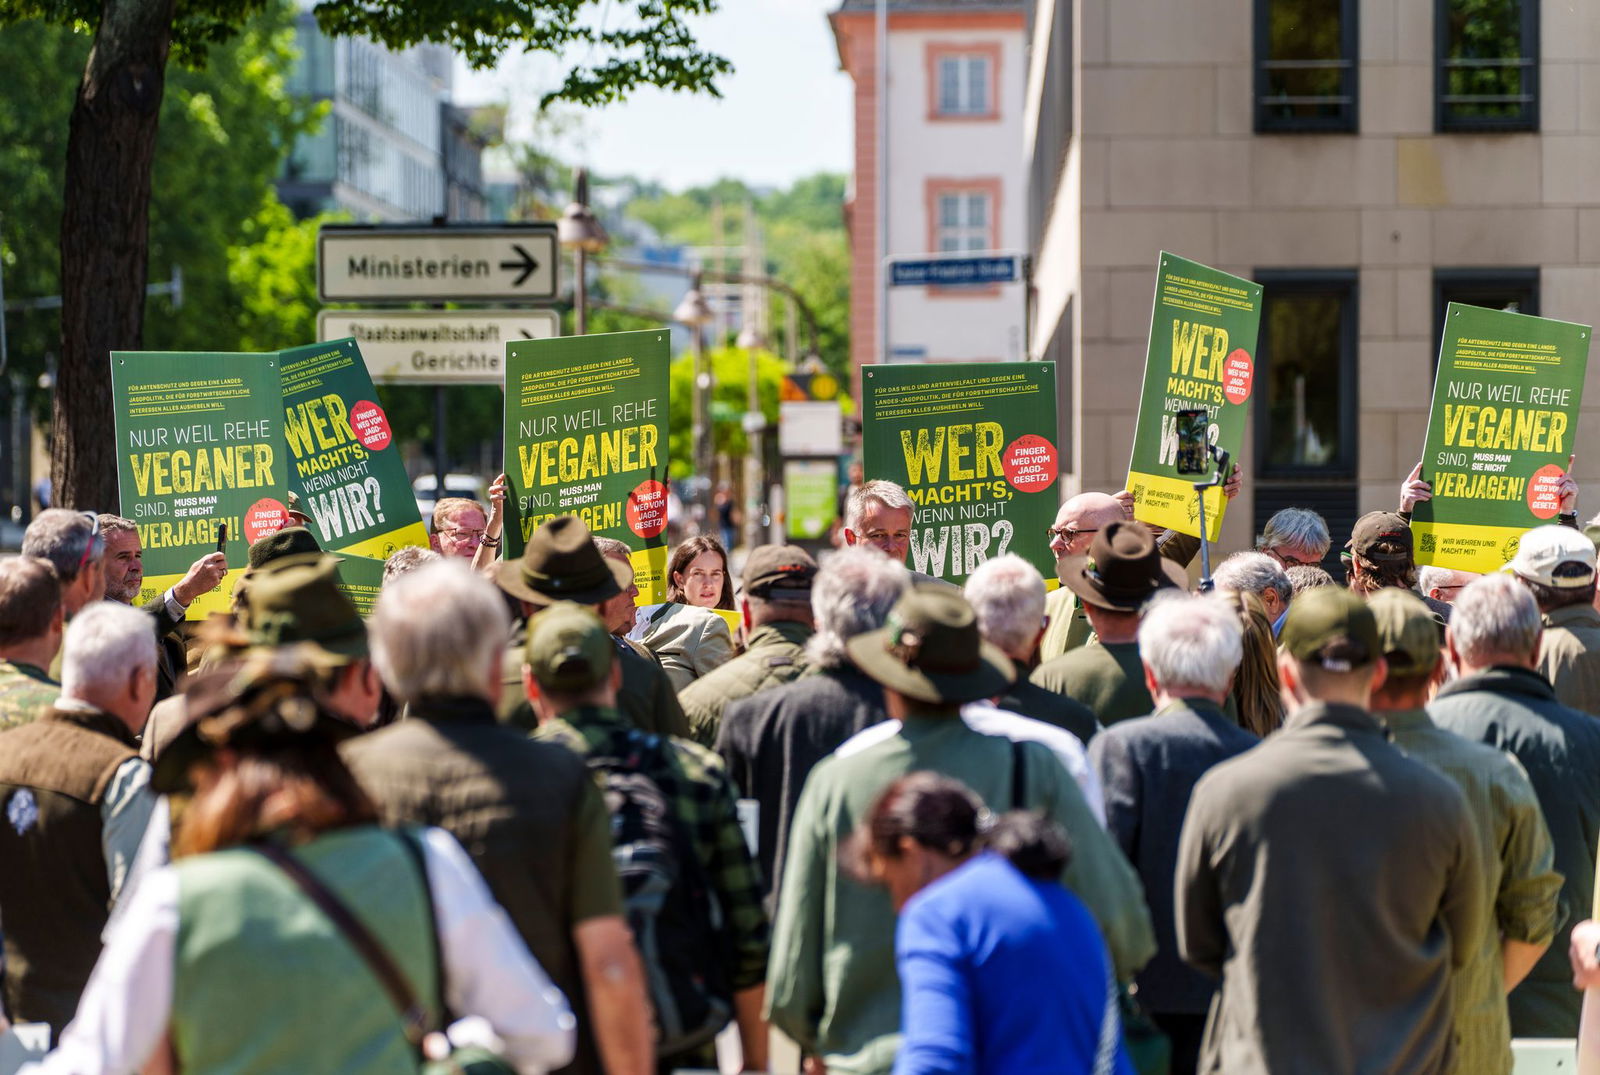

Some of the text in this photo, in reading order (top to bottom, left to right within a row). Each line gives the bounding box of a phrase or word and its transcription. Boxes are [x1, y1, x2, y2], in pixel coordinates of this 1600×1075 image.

[348, 255, 490, 278] Ministerien
[349, 323, 500, 344] Staatsanwaltschaft
[1171, 319, 1229, 382] WER
[411, 350, 499, 371] Gerichte
[533, 367, 569, 378] ARTENSCHUTZ
[613, 356, 634, 365] LANDES-
[931, 379, 976, 388] ARTENVIELFALT
[966, 384, 1038, 396] FORSTWIRTSCHAFTLICHE
[1167, 377, 1224, 407] MACHT'S,
[1447, 380, 1570, 406] NUR WEIL REHE
[876, 408, 912, 416] INTERESSEN
[932, 402, 966, 411] AUSHEBELN
[1164, 397, 1192, 413] WENN
[356, 408, 377, 420] FINGER
[520, 399, 656, 438] NUR WEIL REHE
[284, 394, 357, 459] WER
[356, 415, 383, 429] WEG VOM
[1444, 404, 1568, 453] VEGANER
[129, 420, 270, 447] NUR WEIL REHE
[363, 424, 382, 436] JAGD-
[363, 431, 388, 444] GESETZ!
[518, 423, 657, 489] VEGANER
[900, 420, 1005, 485] WER
[1015, 446, 1046, 456] FINGER
[1472, 452, 1511, 462] MUSS MAN
[297, 444, 369, 478] MACHT'S,
[1010, 455, 1050, 466] WEG VOM
[1436, 452, 1469, 467] SIND,
[1470, 462, 1507, 472] SIE NICHT
[130, 443, 275, 496] VEGANER
[302, 460, 370, 493] WENN NICHT
[1017, 464, 1043, 474] JAGD-
[1013, 473, 1048, 483] GESETZ!
[559, 481, 601, 496] MUSS MAN
[906, 480, 1013, 506] MACHT'S,
[1434, 472, 1526, 501] VERJAGEN!
[174, 494, 217, 506] MUSS MAN
[518, 491, 554, 511] SIND,
[559, 492, 598, 507] SIE NICHT
[636, 491, 660, 502] FINGER
[134, 500, 169, 517] SIND,
[174, 506, 214, 516] SIE NICHT
[308, 477, 386, 543] WIR?
[633, 499, 664, 512] WEG VOM
[960, 501, 1007, 519] NICHT
[254, 510, 281, 519] FINGER
[637, 509, 660, 520] JAGD-
[251, 518, 285, 528] WEG VOM
[634, 518, 663, 530] GESETZ!
[908, 518, 1015, 579] WIR?
[1454, 538, 1481, 546] WEHREN
